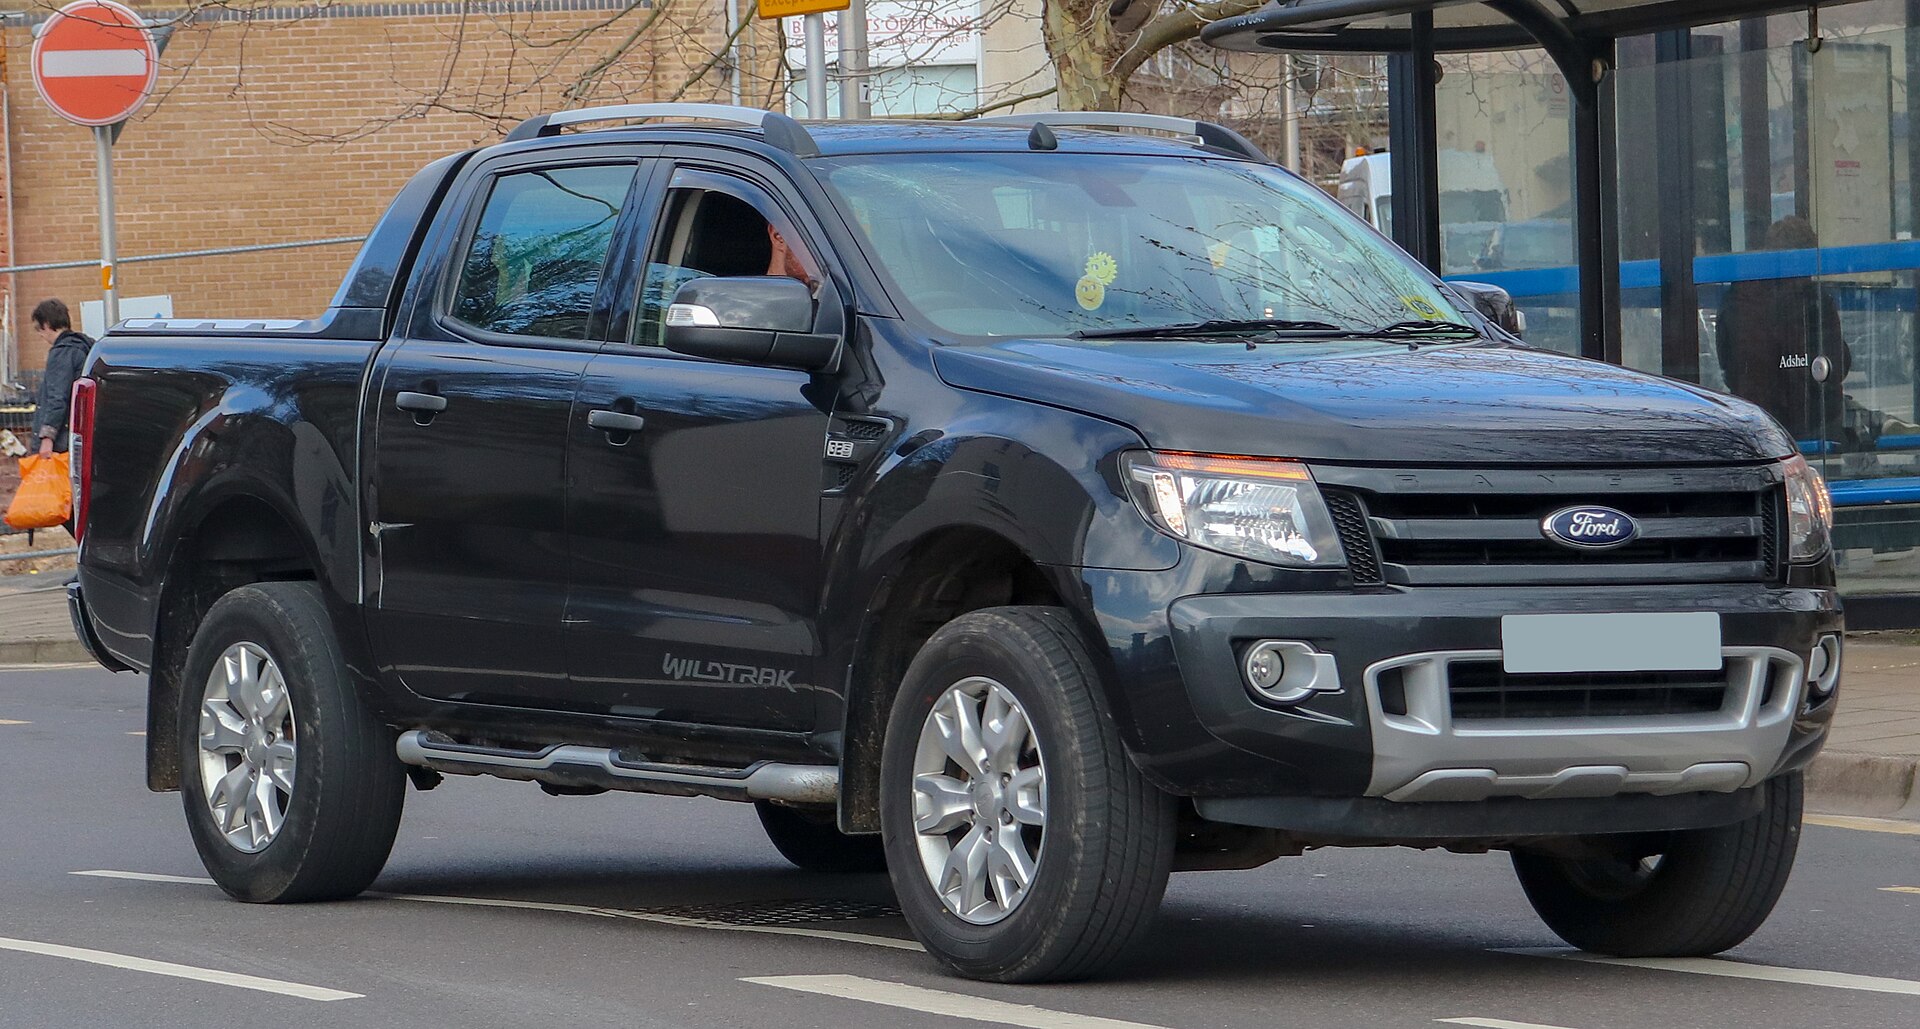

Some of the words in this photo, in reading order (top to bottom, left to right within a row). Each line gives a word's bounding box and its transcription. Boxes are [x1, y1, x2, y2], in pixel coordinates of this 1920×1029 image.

[1779, 353, 1808, 368] Adshel
[1569, 512, 1620, 536] Ford
[662, 653, 797, 693] WILDTRAK
